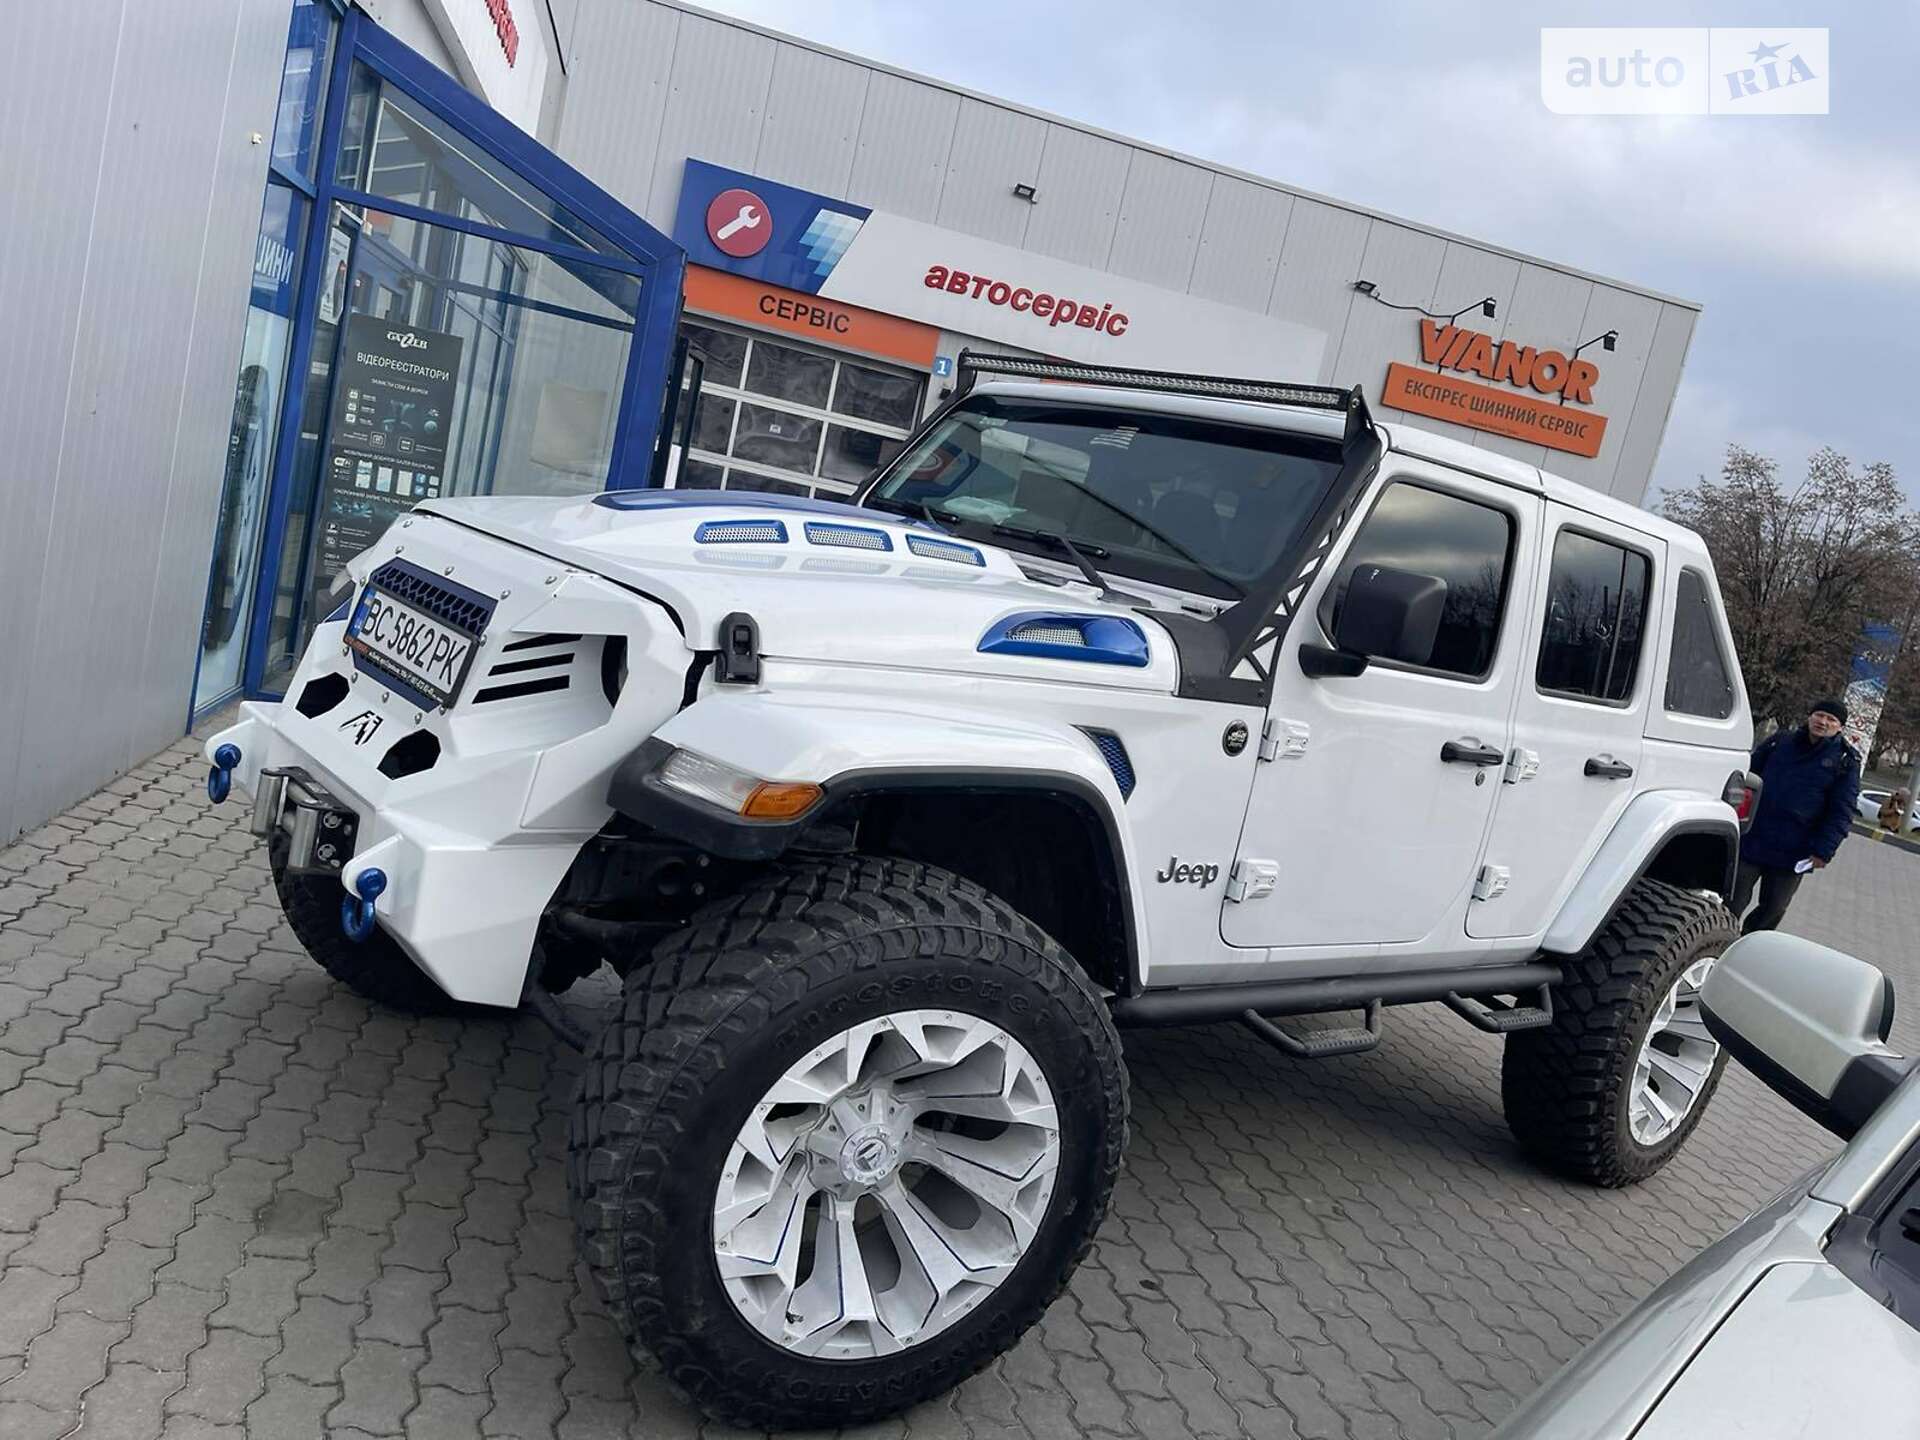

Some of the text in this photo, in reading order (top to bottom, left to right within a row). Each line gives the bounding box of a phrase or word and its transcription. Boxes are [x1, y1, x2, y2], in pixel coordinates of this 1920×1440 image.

[758, 294, 851, 334] СЕРВІС
[924, 263, 1130, 337] автосервіс
[356, 351, 450, 381] ВІДЕОРЕЄСТРАТОРИ
[1420, 318, 1600, 404] VIANOR
[1405, 379, 1467, 408] ЕКСПРЕС
[1470, 396, 1536, 424] ШИННИЙ
[1539, 415, 1589, 440] СЕРВІС
[1156, 855, 1219, 889] Jeep
